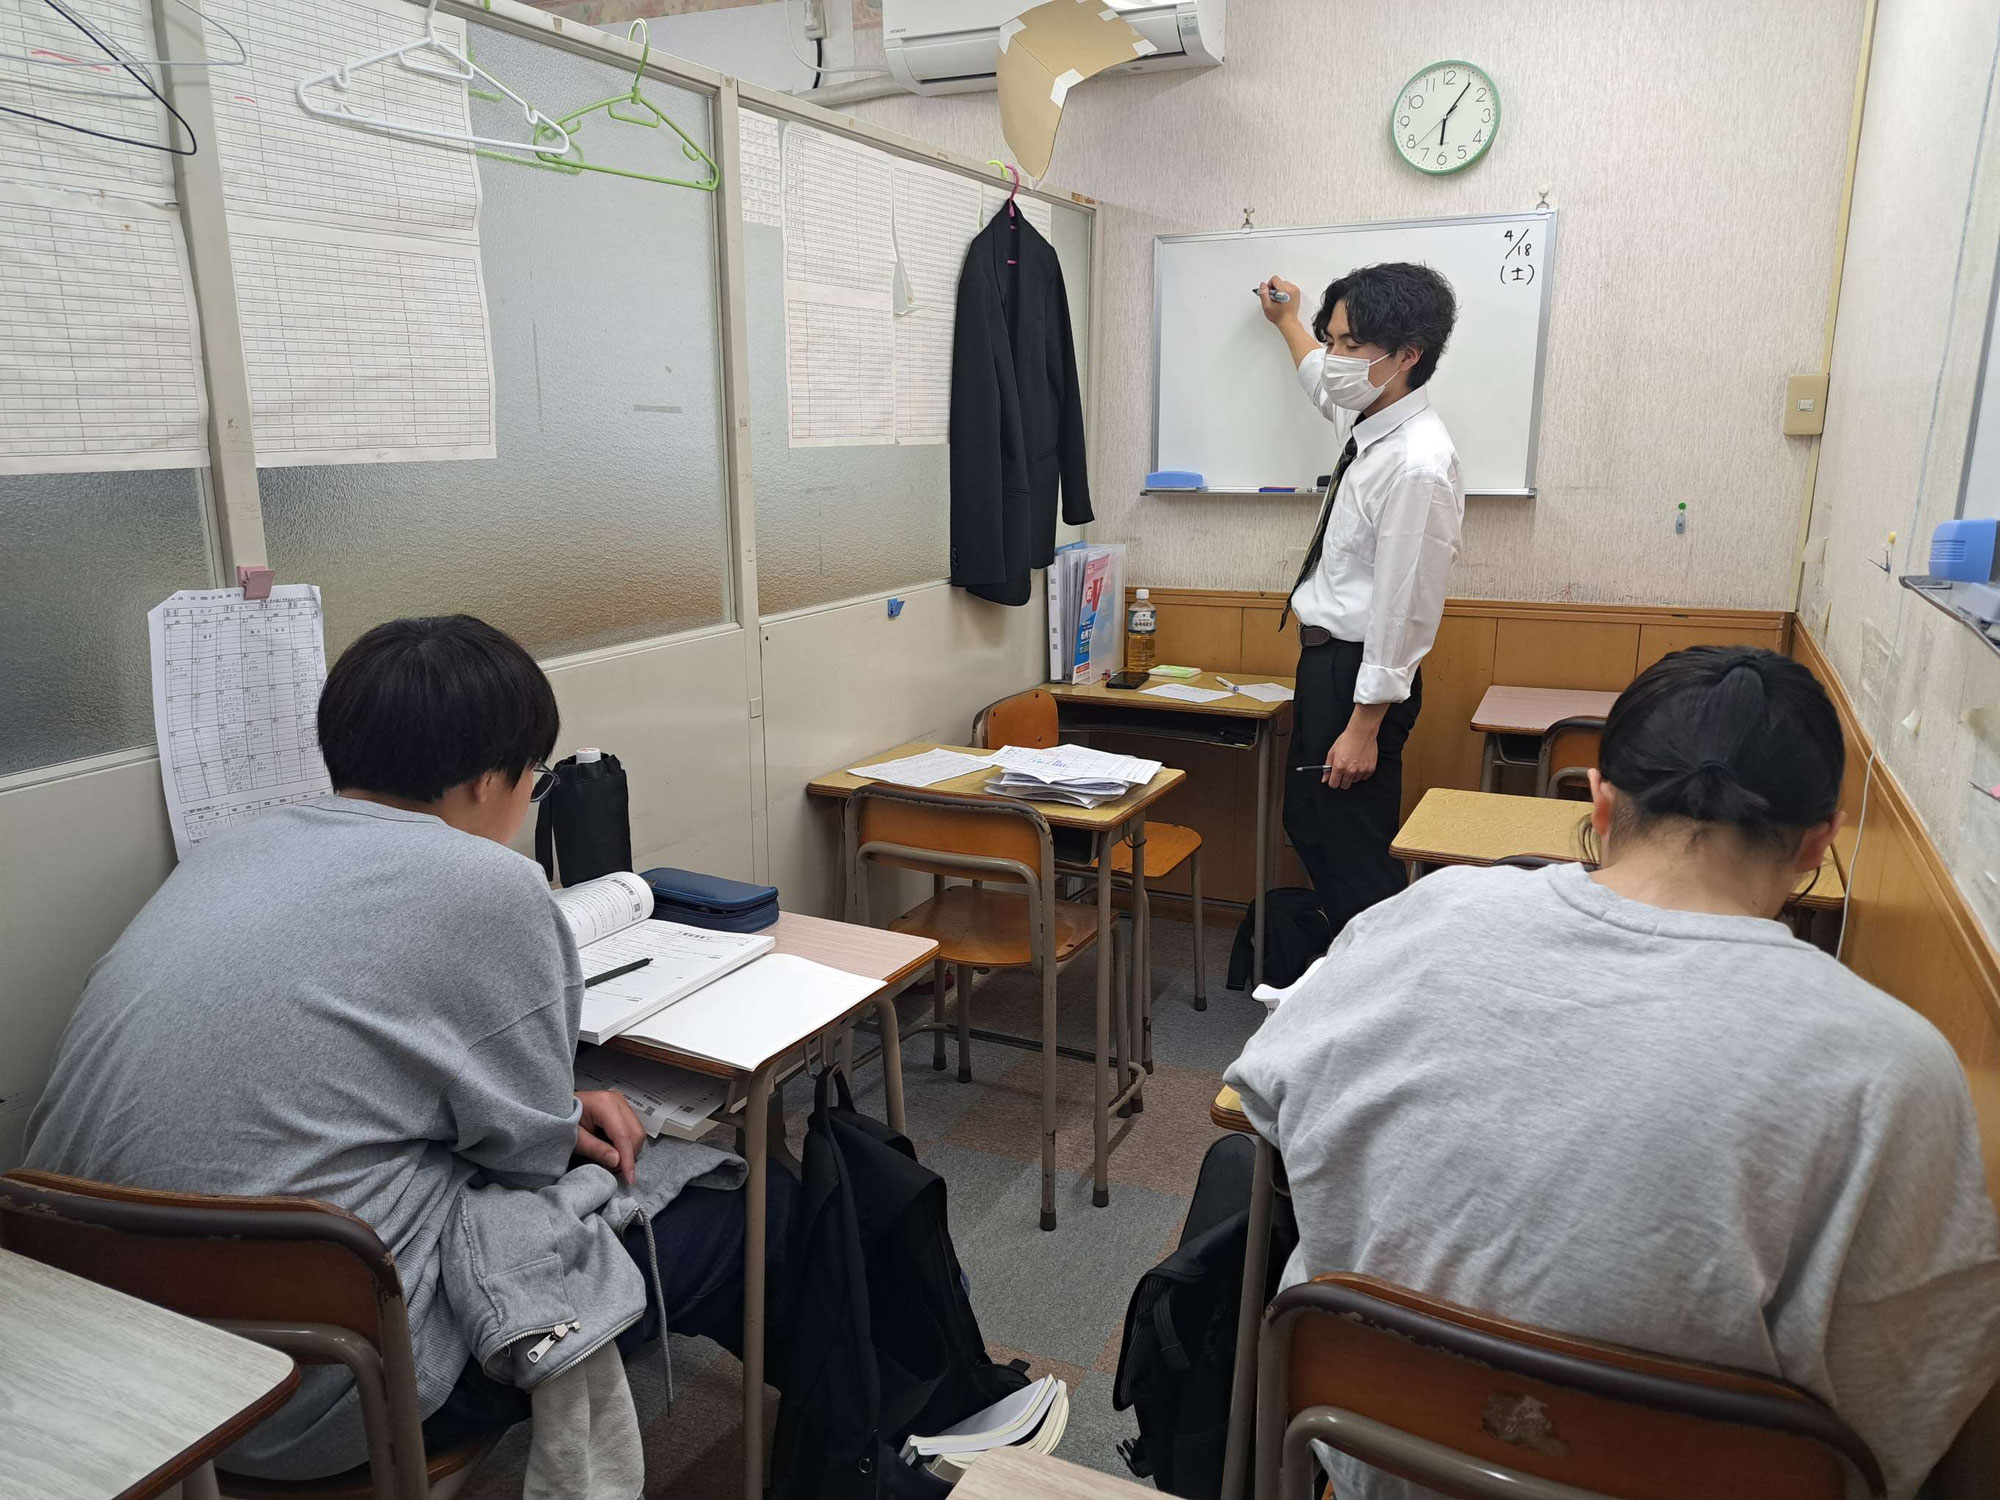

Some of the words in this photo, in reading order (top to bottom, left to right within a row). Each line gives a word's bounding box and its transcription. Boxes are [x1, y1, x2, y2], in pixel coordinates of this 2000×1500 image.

[1443, 70, 1457, 85] 12
[1425, 78, 1436, 93] 11
[1408, 94, 1424, 110] 10
[1476, 87, 1487, 103] 2
[1400, 115, 1410, 130] 9
[1481, 108, 1491, 124] 3
[1406, 133, 1416, 149] 8
[1472, 128, 1482, 144] 4
[1421, 147, 1430, 161] 7
[1436, 151, 1447, 166] 6
[1457, 145, 1467, 160] 5
[1504, 229, 1532, 259] 4/18
